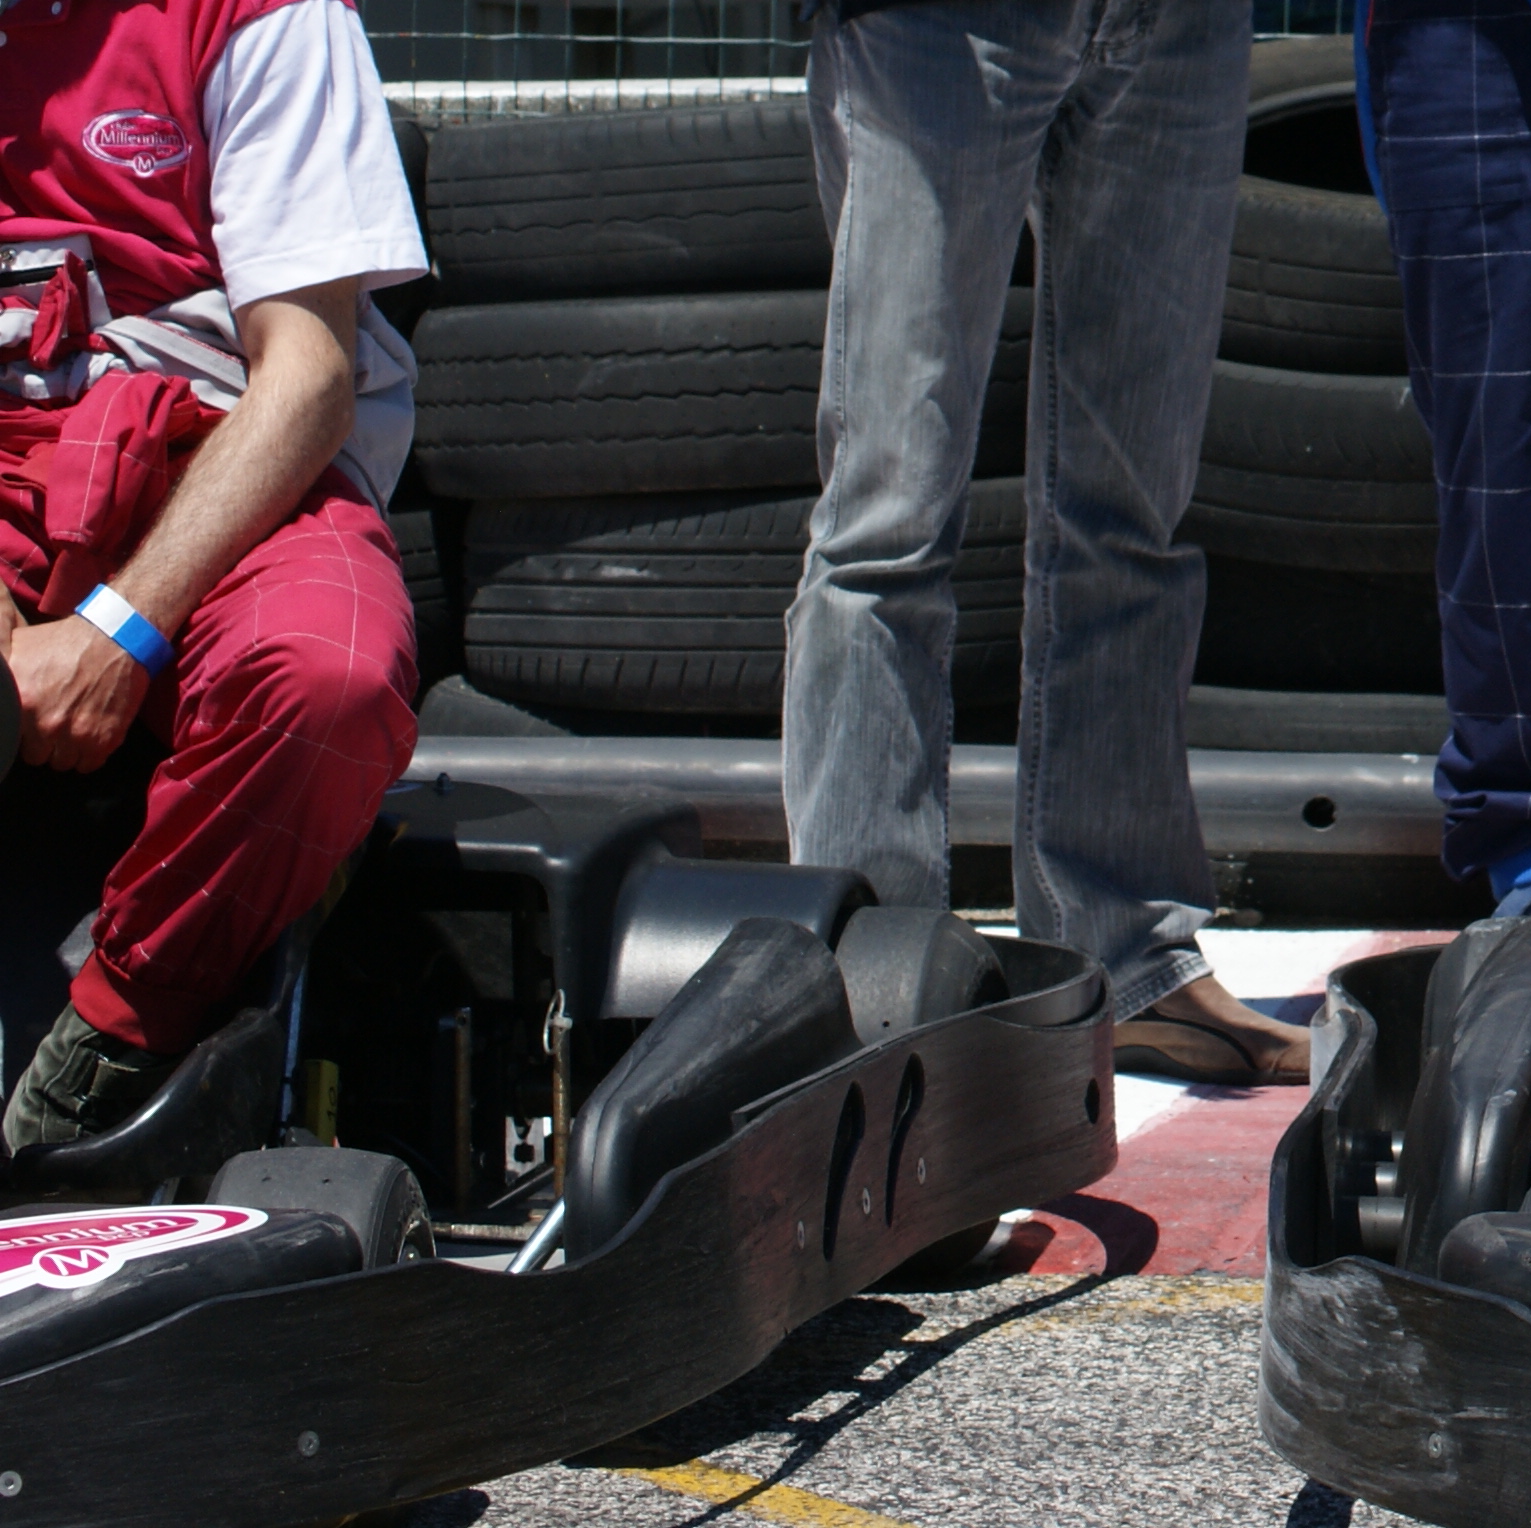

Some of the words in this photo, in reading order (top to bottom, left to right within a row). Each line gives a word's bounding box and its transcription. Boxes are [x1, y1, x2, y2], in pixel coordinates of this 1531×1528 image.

[100, 128, 180, 146] Millennium
[137, 156, 152, 171] M
[44, 1249, 111, 1278] M
